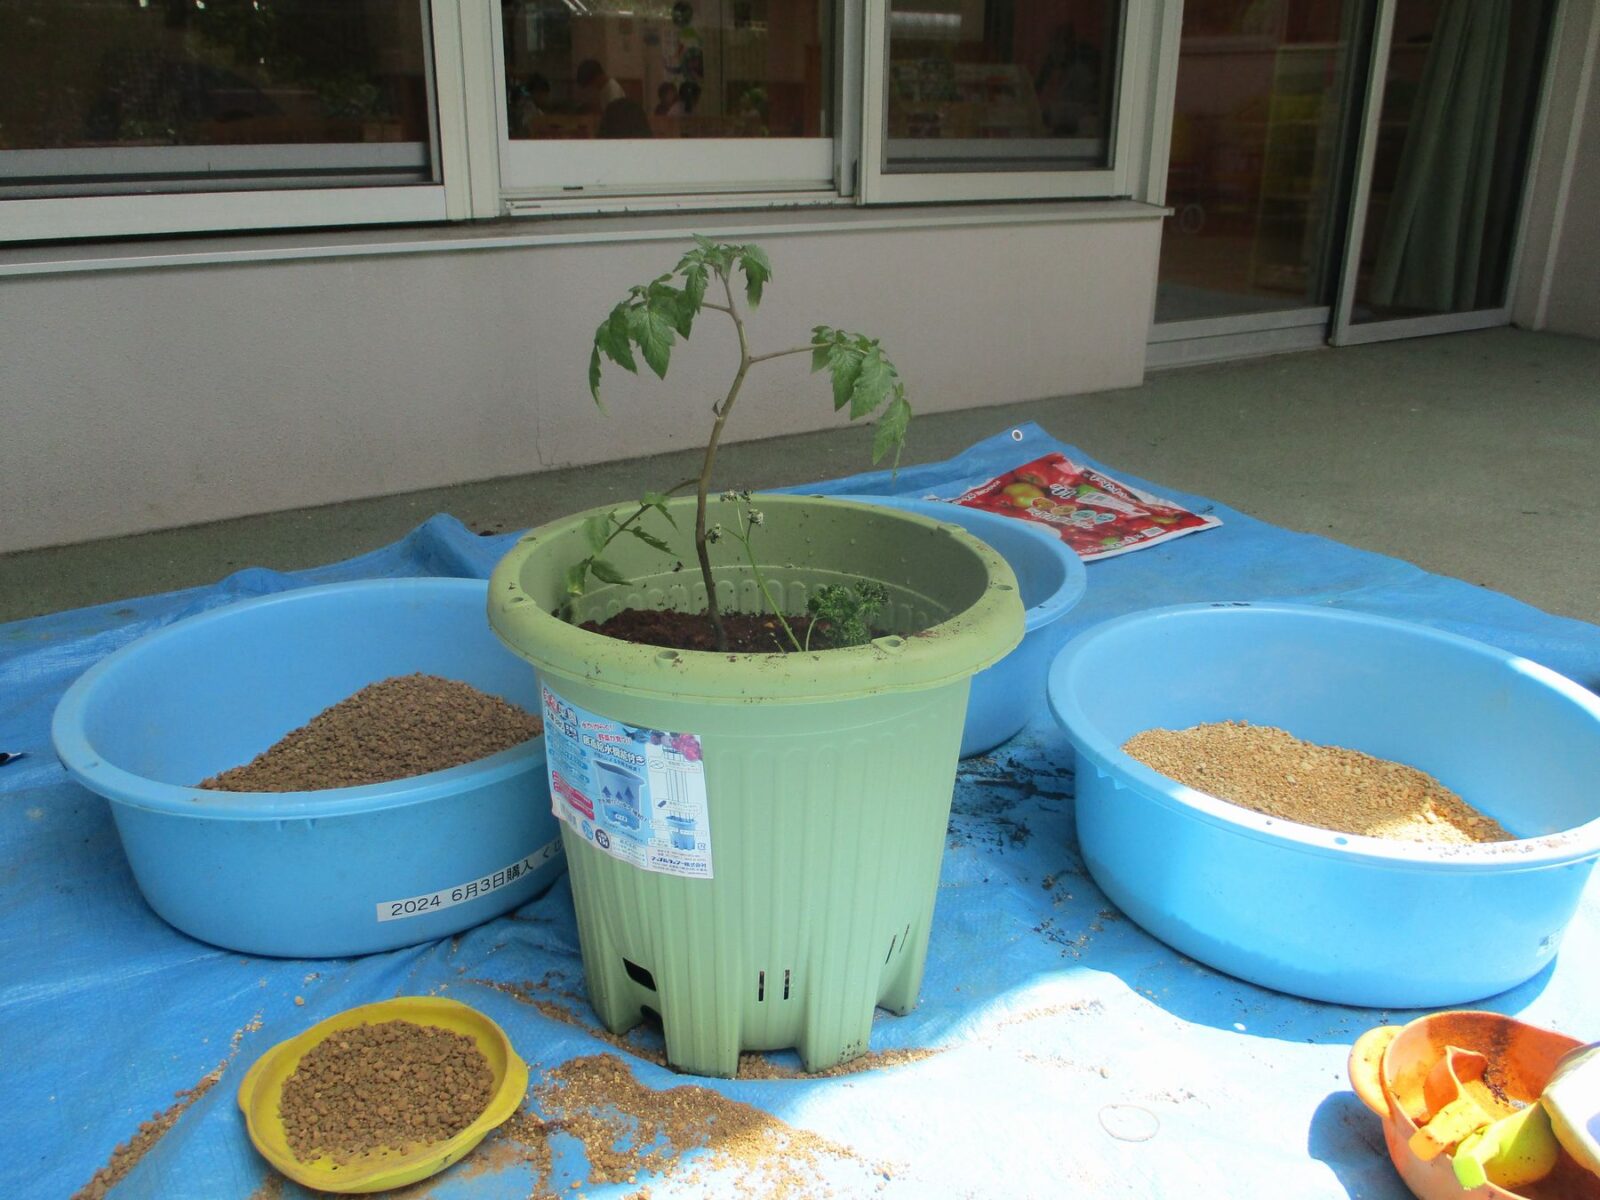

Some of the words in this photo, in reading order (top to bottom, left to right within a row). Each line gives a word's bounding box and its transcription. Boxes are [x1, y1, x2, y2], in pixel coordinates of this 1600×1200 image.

[391, 895, 442, 917] 2024
[451, 859, 534, 902] 6月3日購入
